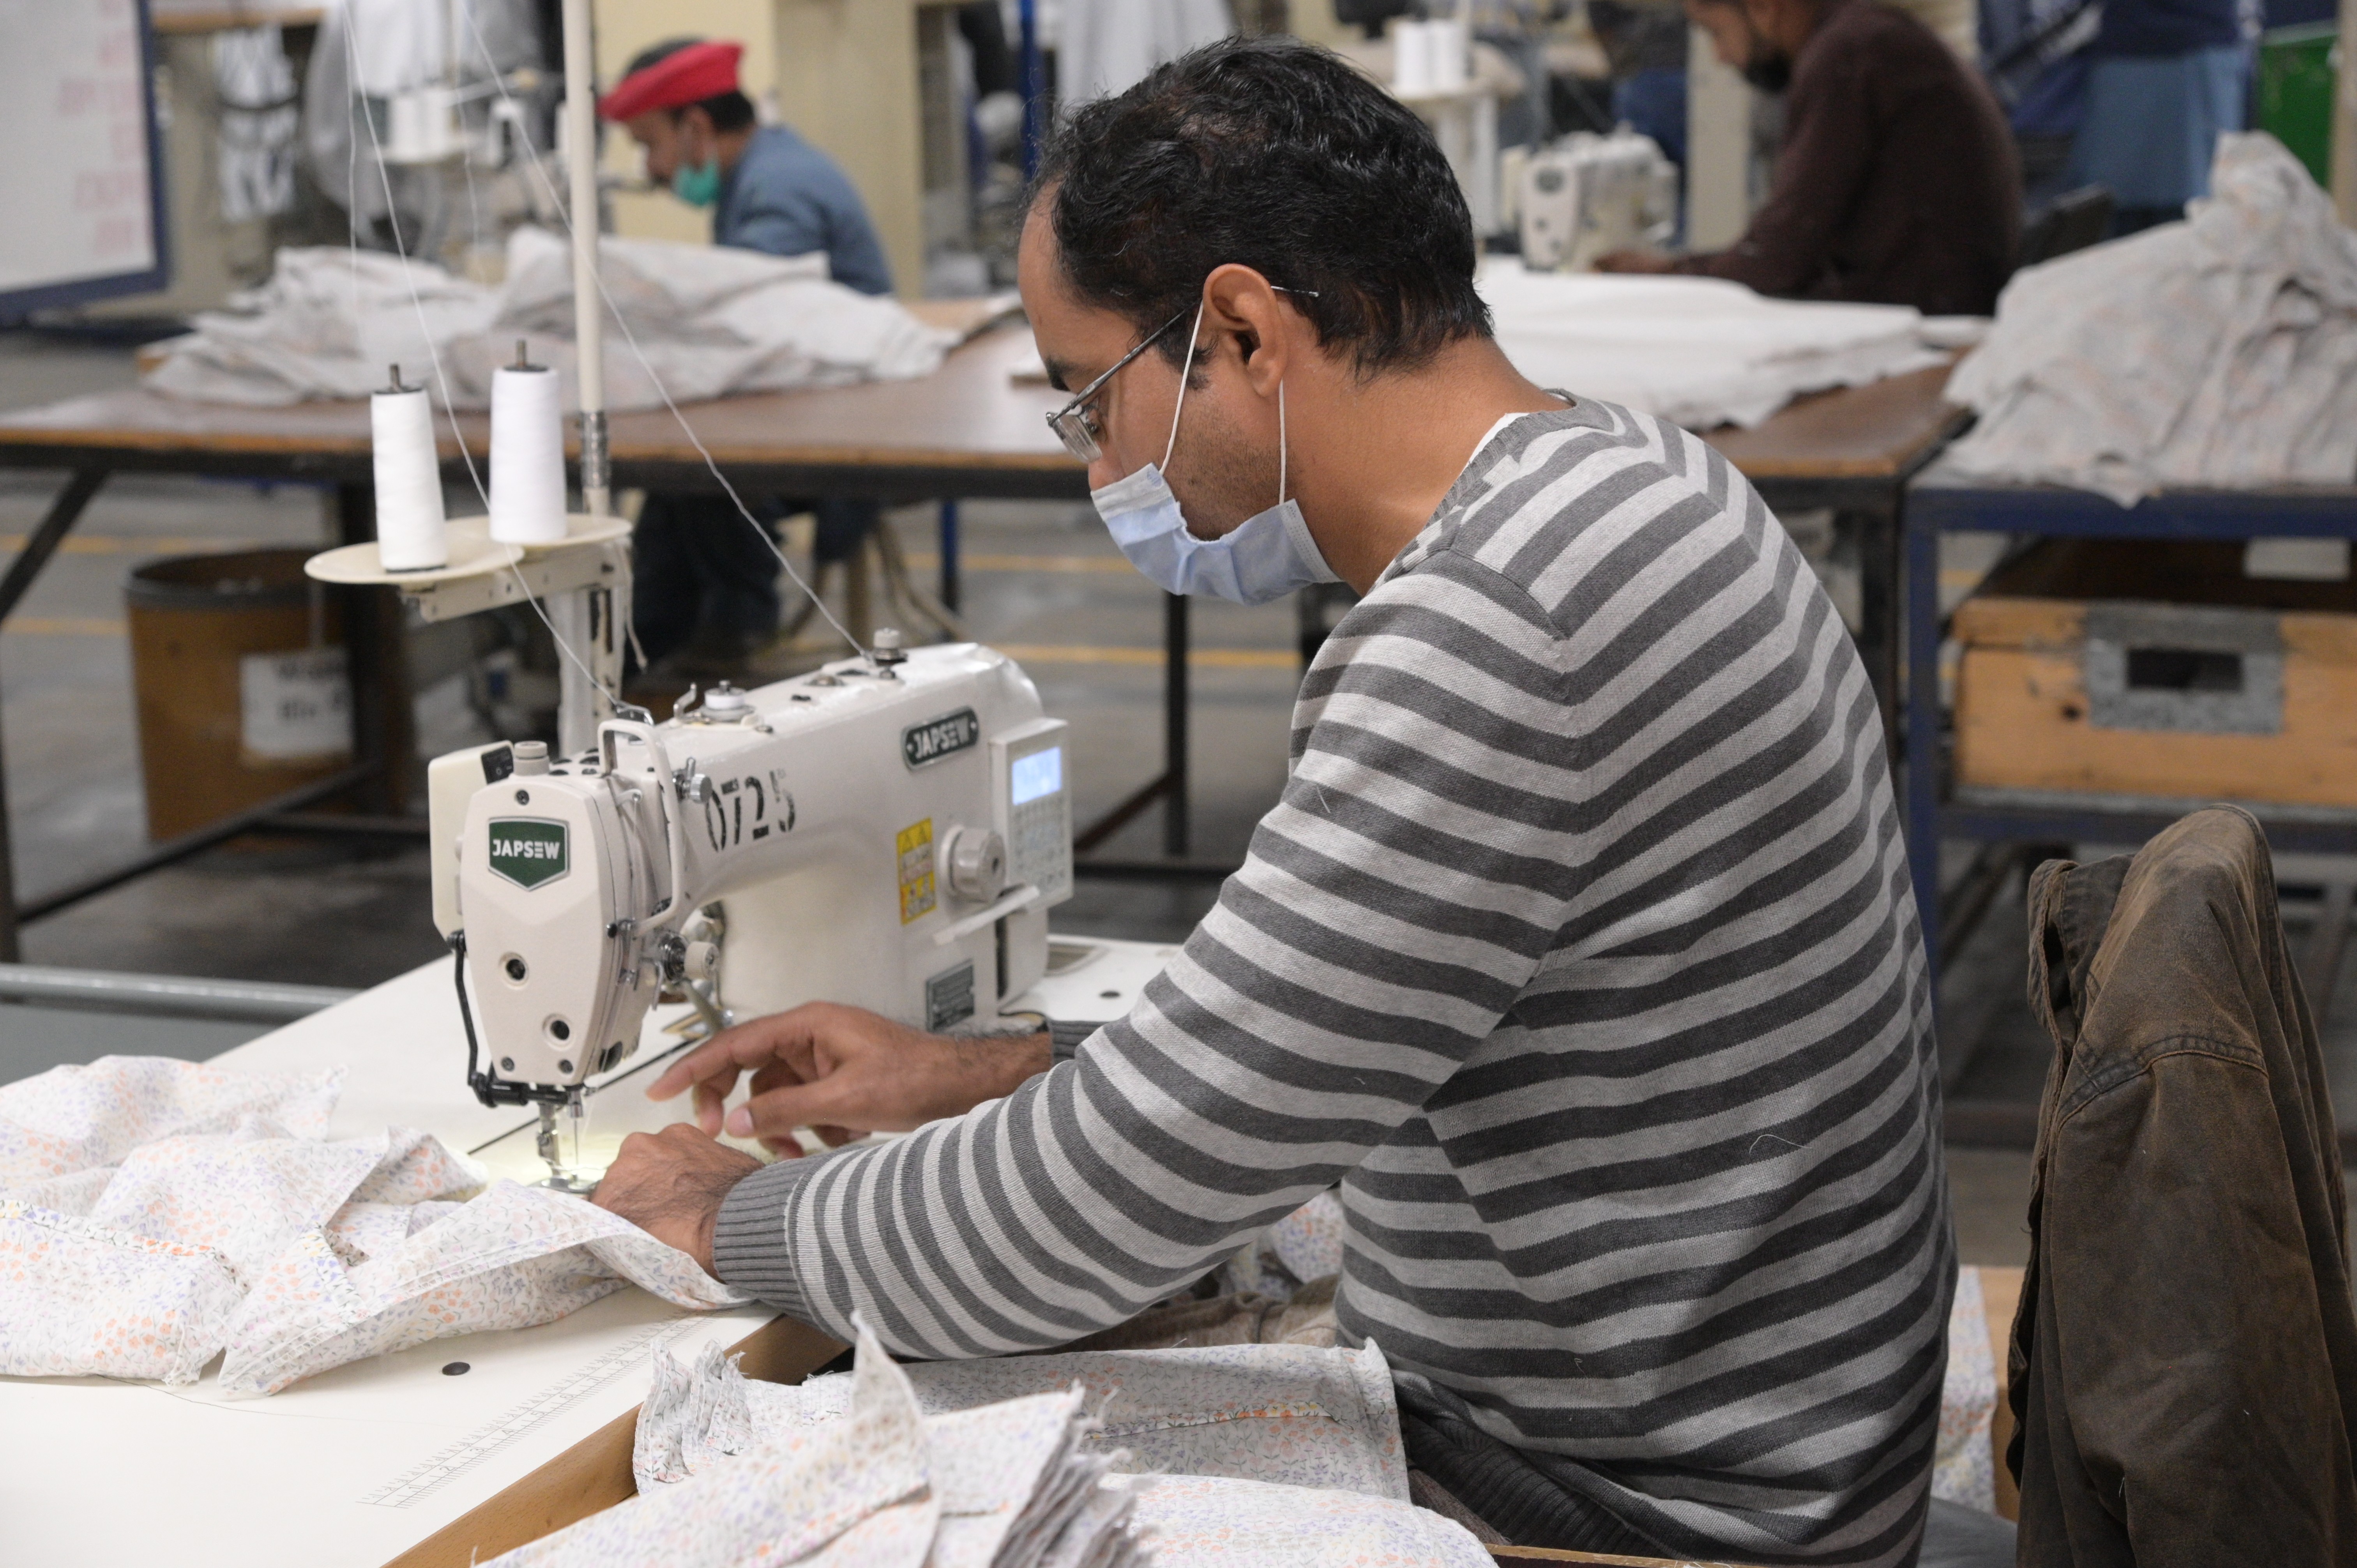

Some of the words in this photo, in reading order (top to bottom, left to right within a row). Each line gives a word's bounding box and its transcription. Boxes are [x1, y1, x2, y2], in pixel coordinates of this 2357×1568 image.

[913, 716, 970, 759] JAPSEW
[704, 769, 796, 853] 0725
[492, 839, 560, 860] JAPSEW
